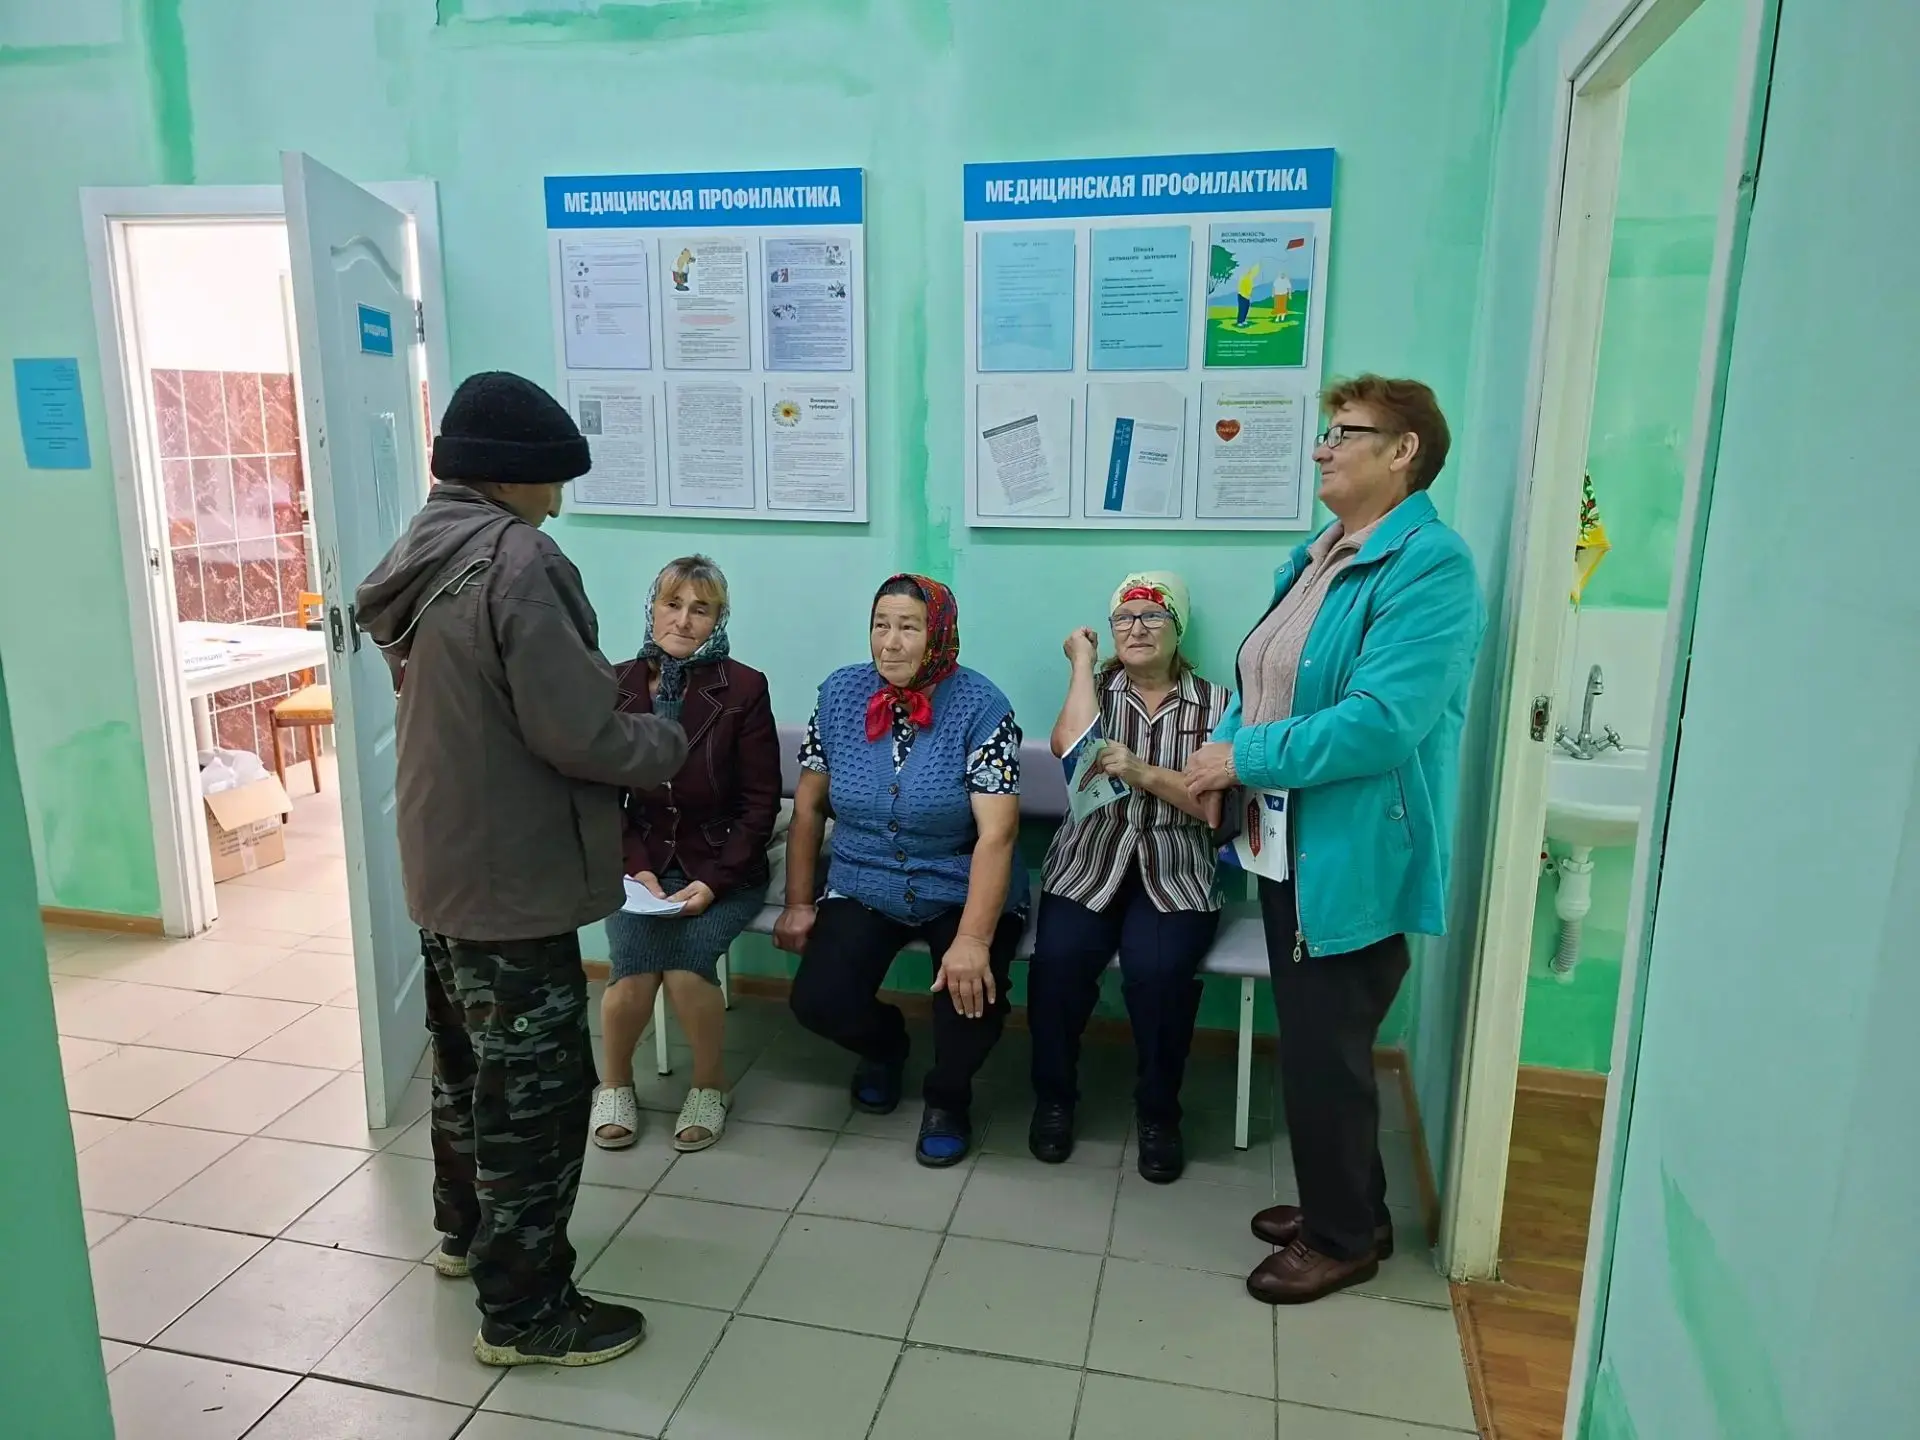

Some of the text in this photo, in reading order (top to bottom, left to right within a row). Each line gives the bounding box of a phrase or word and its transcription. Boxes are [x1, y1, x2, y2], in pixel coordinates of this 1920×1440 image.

[563, 185, 841, 215] МЕДИЦИНСКАЯ ПРОФИЛАКТИКА
[985, 167, 1308, 204] МЕДИЦИНСКАЯ ПРОФИЛАКТИКА
